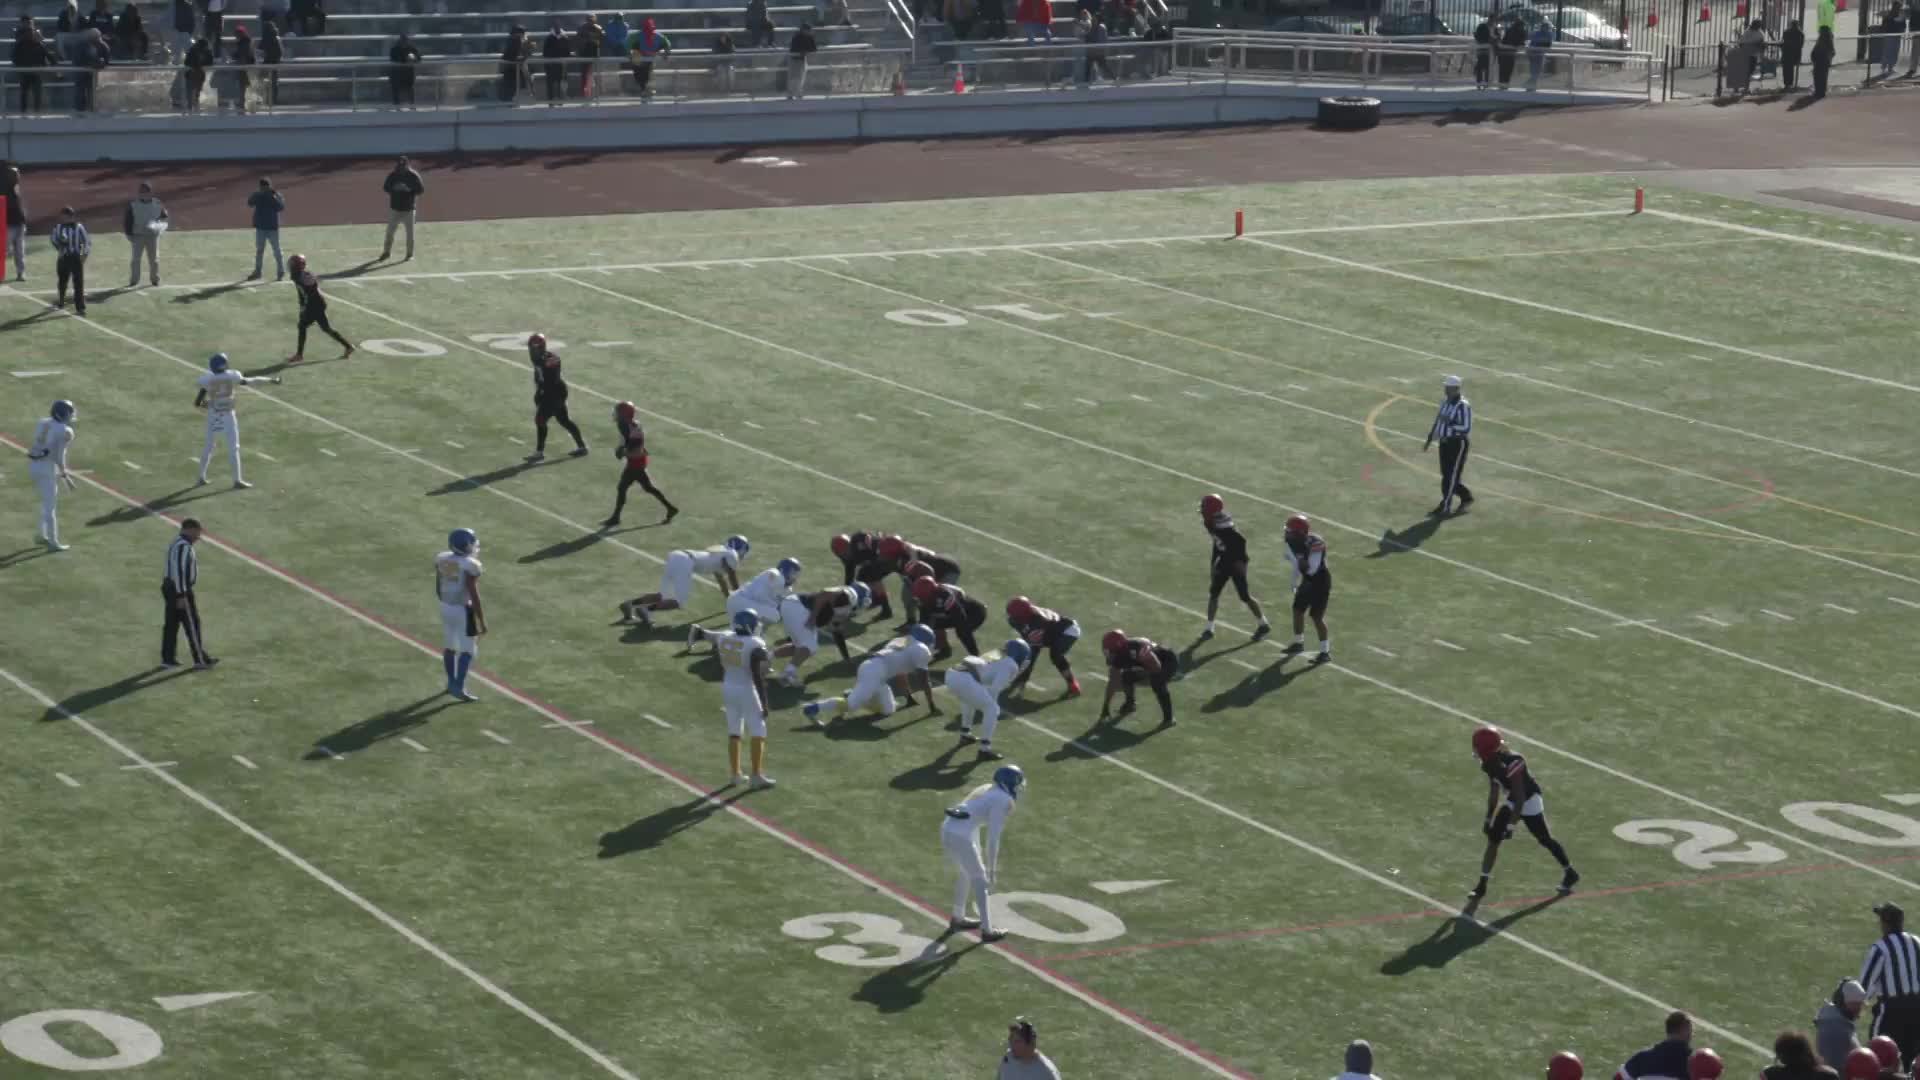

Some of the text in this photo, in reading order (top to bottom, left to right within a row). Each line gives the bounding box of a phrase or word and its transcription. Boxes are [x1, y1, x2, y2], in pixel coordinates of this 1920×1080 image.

[884, 303, 1066, 327] 10
[1612, 801, 1920, 869] 20
[781, 891, 1126, 966] 30
